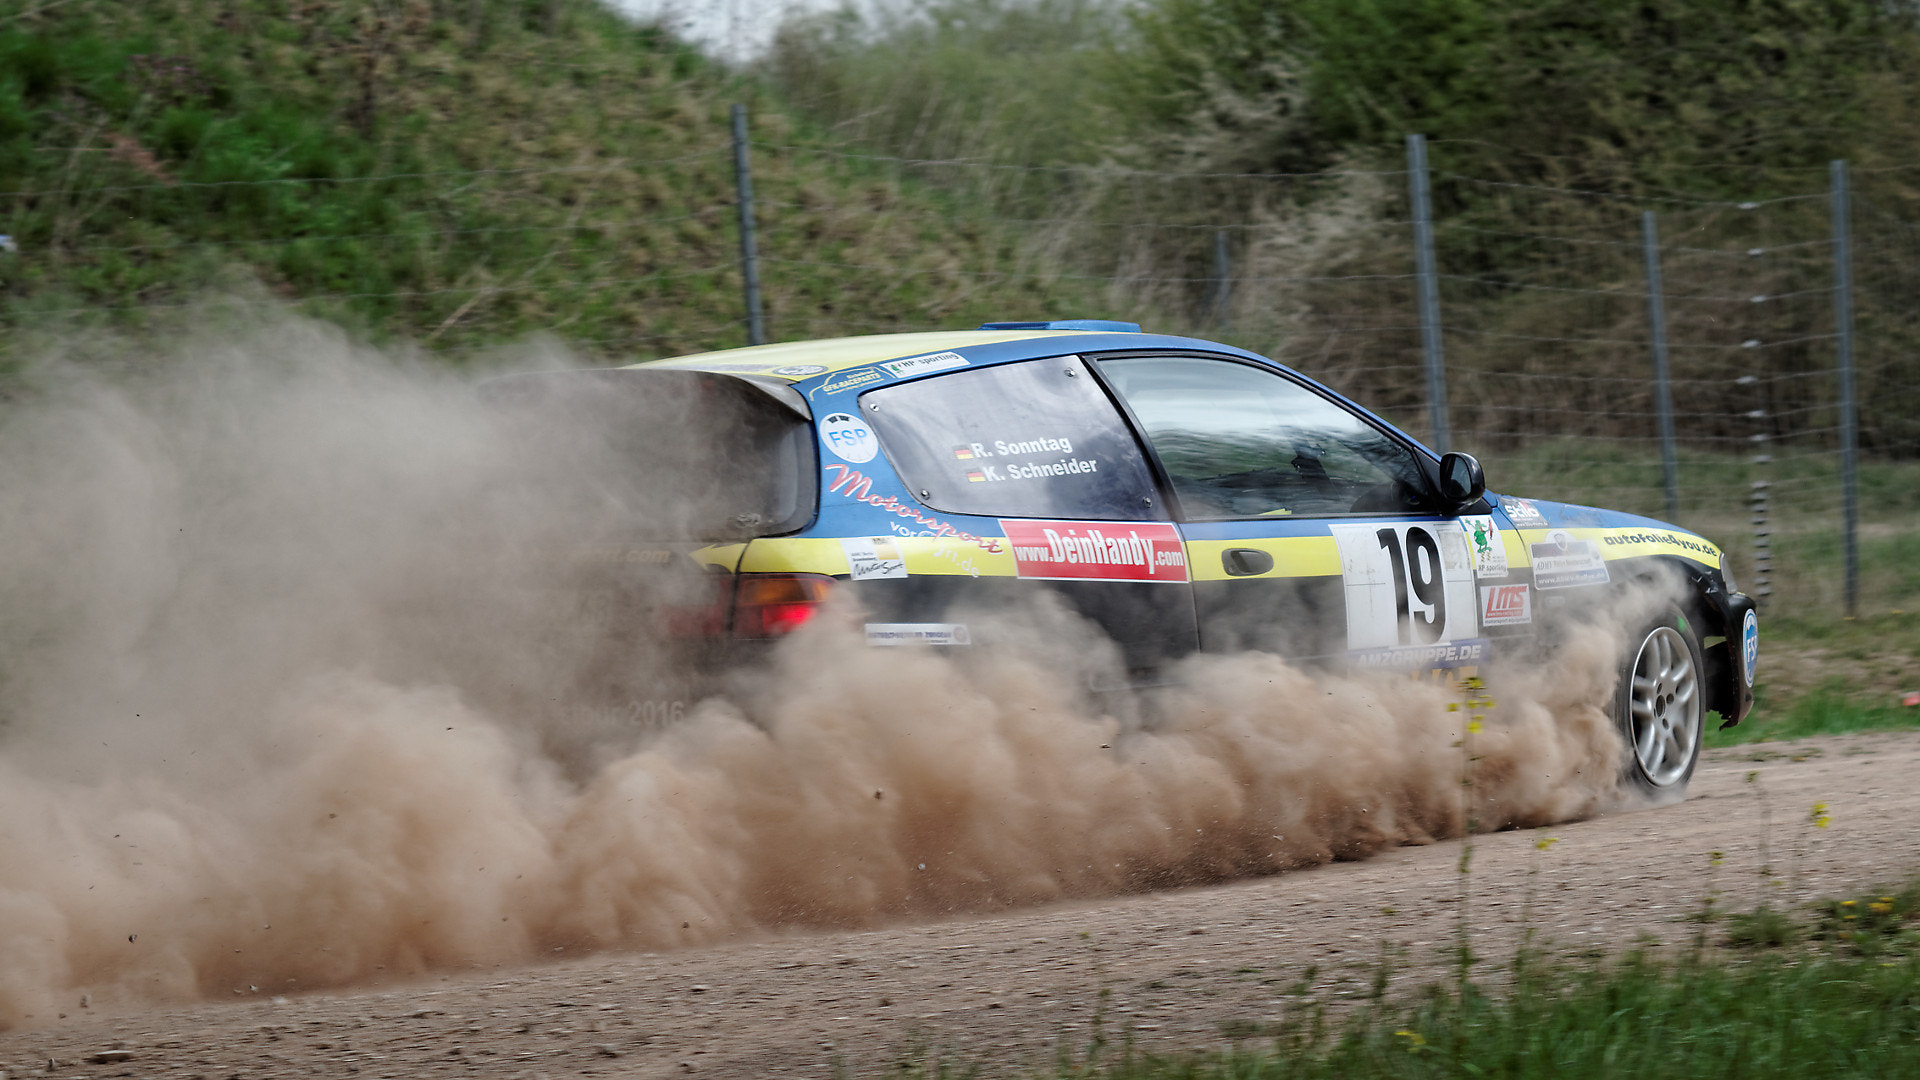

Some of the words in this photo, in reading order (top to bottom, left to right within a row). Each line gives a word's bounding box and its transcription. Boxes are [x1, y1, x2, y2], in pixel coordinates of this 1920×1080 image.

[920, 353, 959, 365] sporting
[828, 428, 867, 448] FSP
[971, 442, 993, 458] R.
[998, 435, 1073, 455] Sonntag
[982, 466, 1006, 481] K.
[1007, 458, 1098, 480] Schneider
[825, 463, 1004, 554] Motorsport
[1013, 528, 1185, 575] www.DeinHandy.com
[1604, 533, 1718, 557] autofolie4you.de
[1376, 526, 1446, 646] 19
[1357, 644, 1482, 667] AMZGRUPPE.DE
[627, 700, 685, 725] 2016
